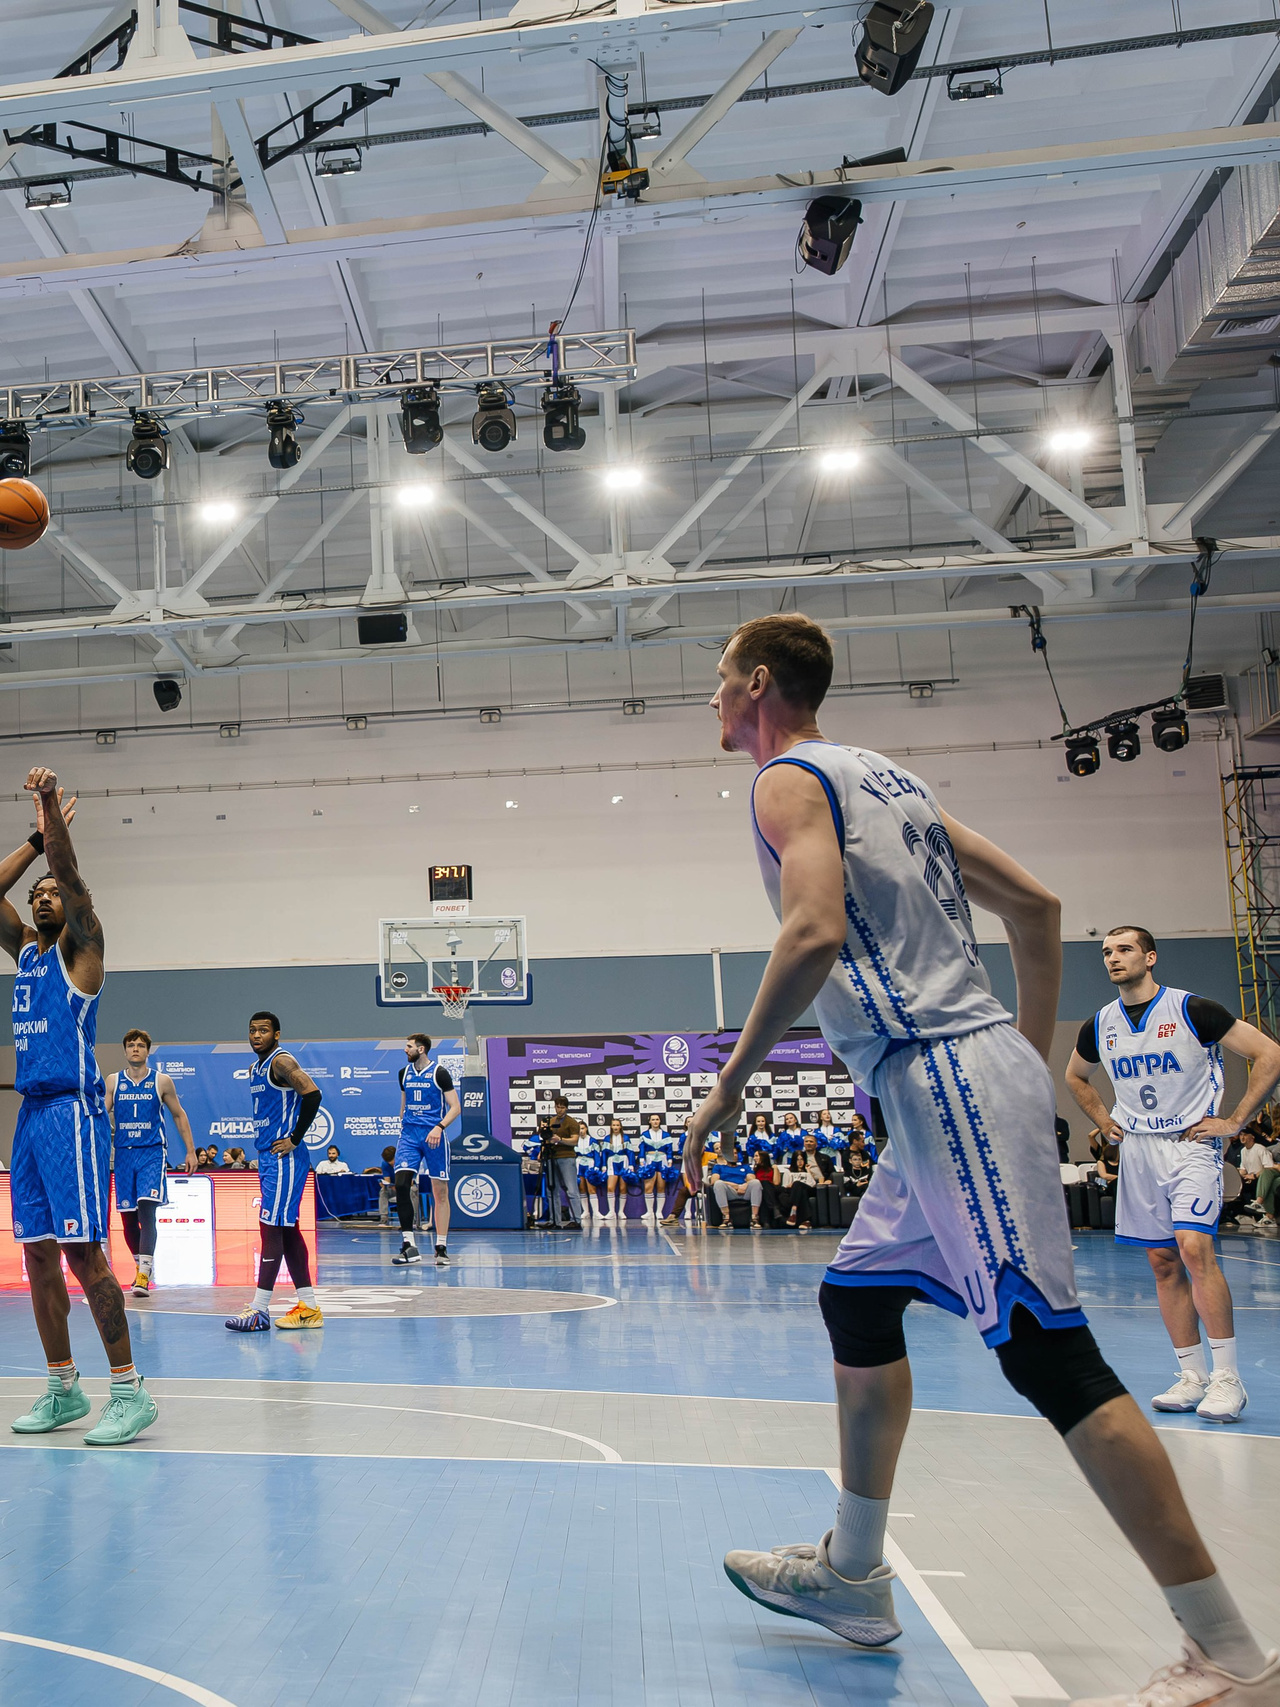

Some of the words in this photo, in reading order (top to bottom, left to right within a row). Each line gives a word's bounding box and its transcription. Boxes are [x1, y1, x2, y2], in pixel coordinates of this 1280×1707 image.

[13, 1018, 48, 1035] ОРСКИЙ
[1158, 1023, 1176, 1032] FON
[15, 1036, 28, 1052] РАЙ
[1109, 1050, 1184, 1081] ЮГРА
[413, 1090, 422, 1102] 10
[1139, 1084, 1158, 1110] 6
[133, 1103, 137, 1118] 1
[209, 1122, 255, 1135] ДИНА
